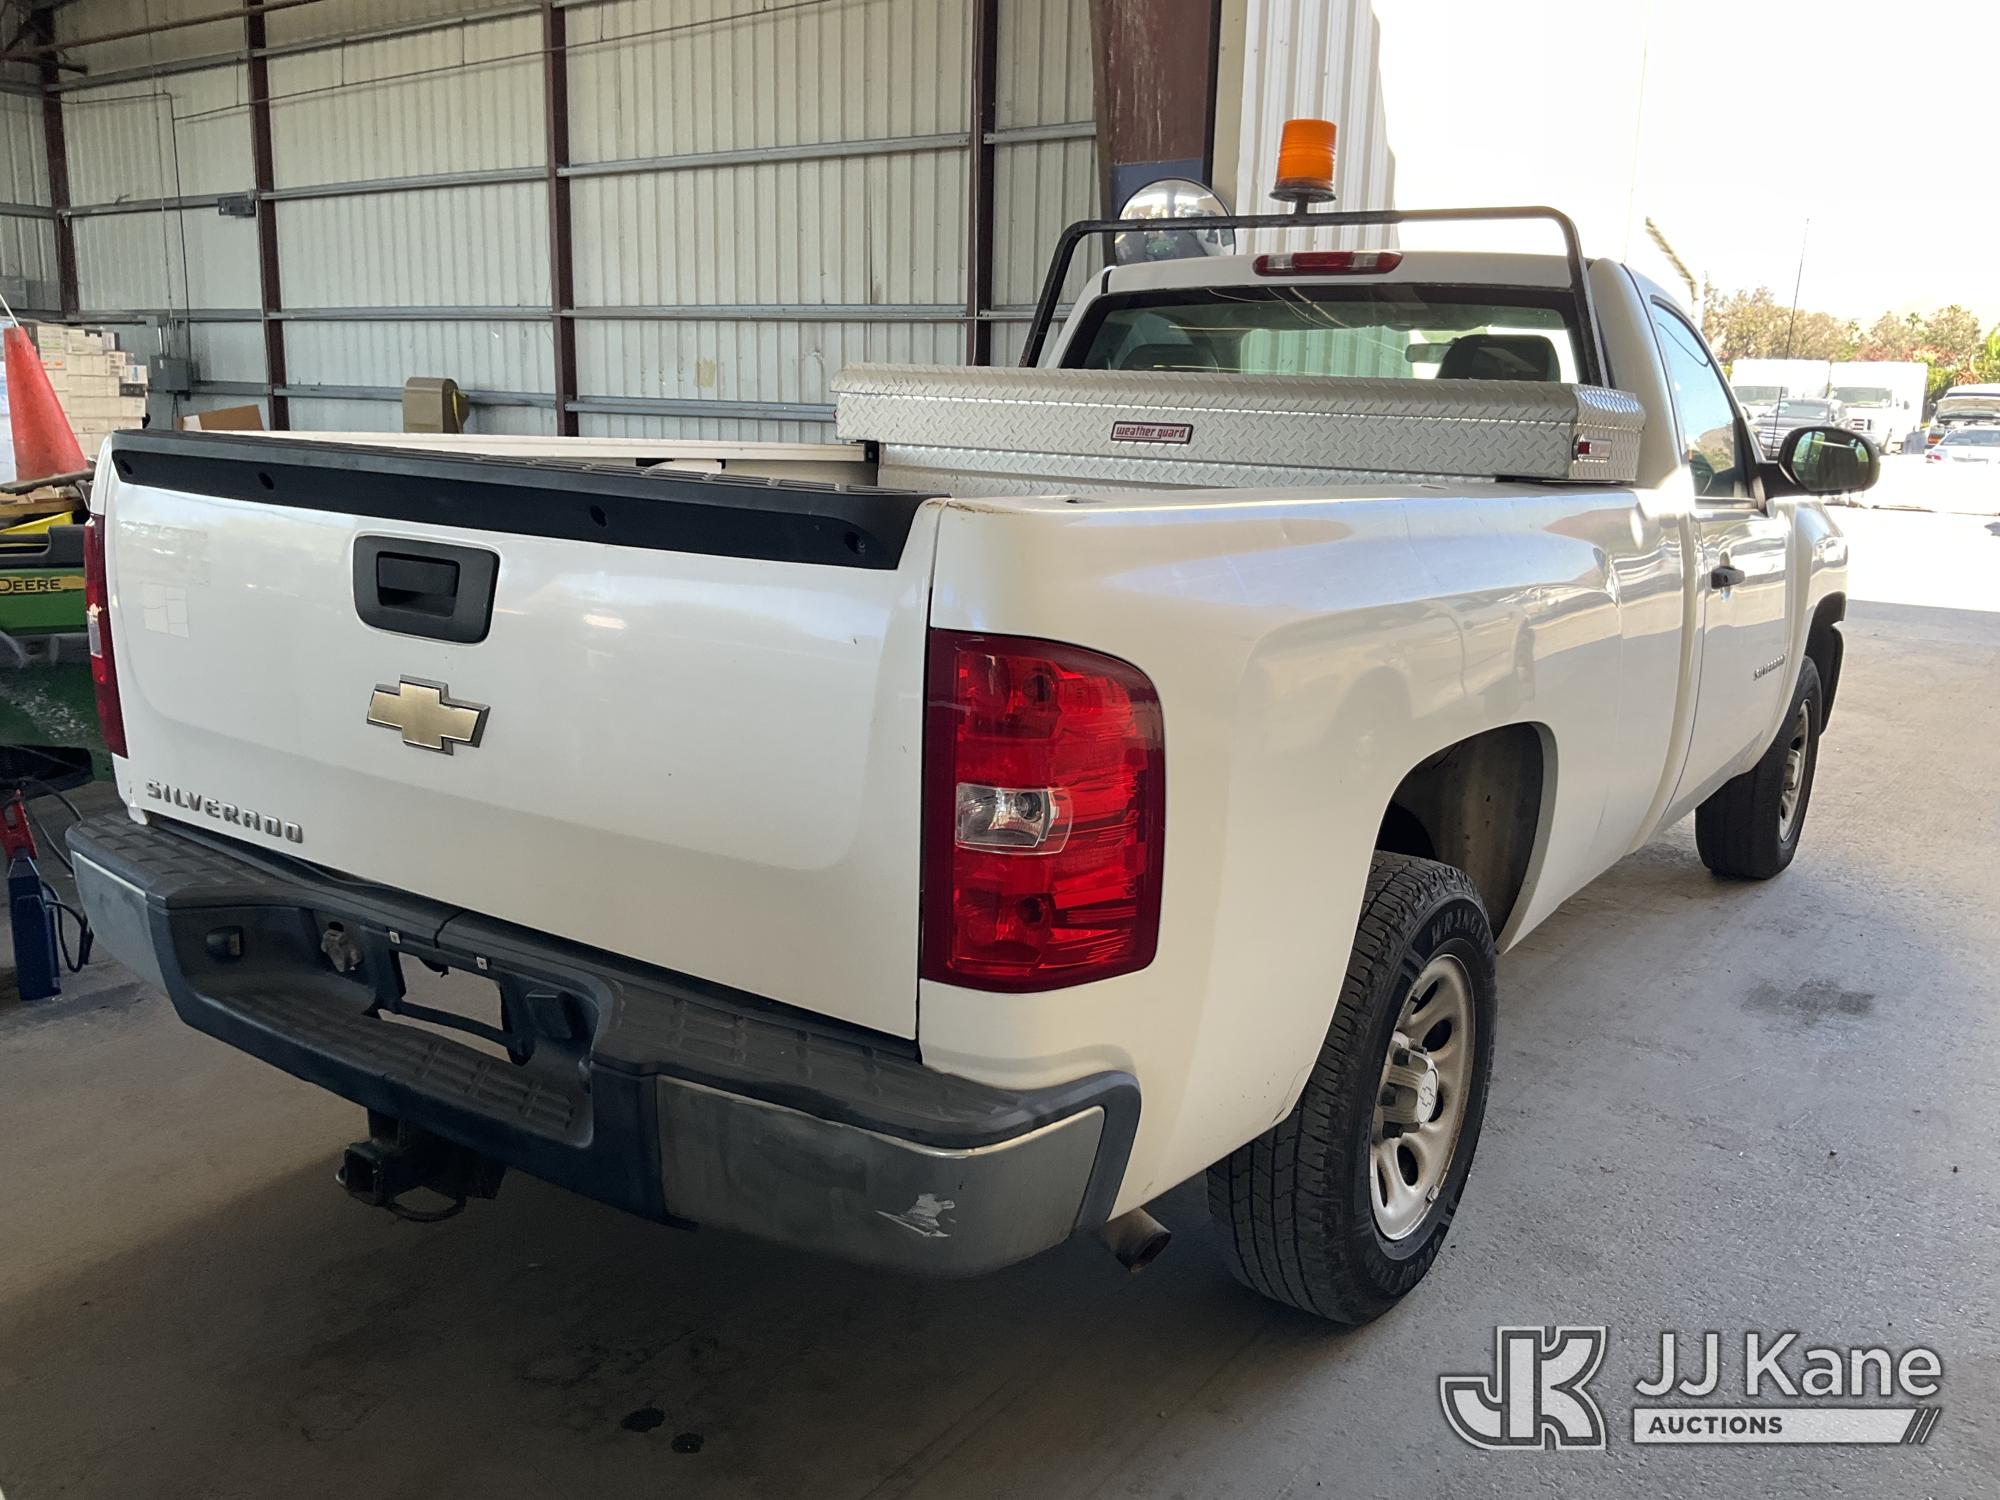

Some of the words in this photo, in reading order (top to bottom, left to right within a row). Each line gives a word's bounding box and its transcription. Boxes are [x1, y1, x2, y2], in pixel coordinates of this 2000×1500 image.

[1115, 426, 1156, 437] weather
[1157, 428, 1186, 440] guard
[0, 578, 61, 592] DEERE
[146, 779, 303, 844] SILVERADO
